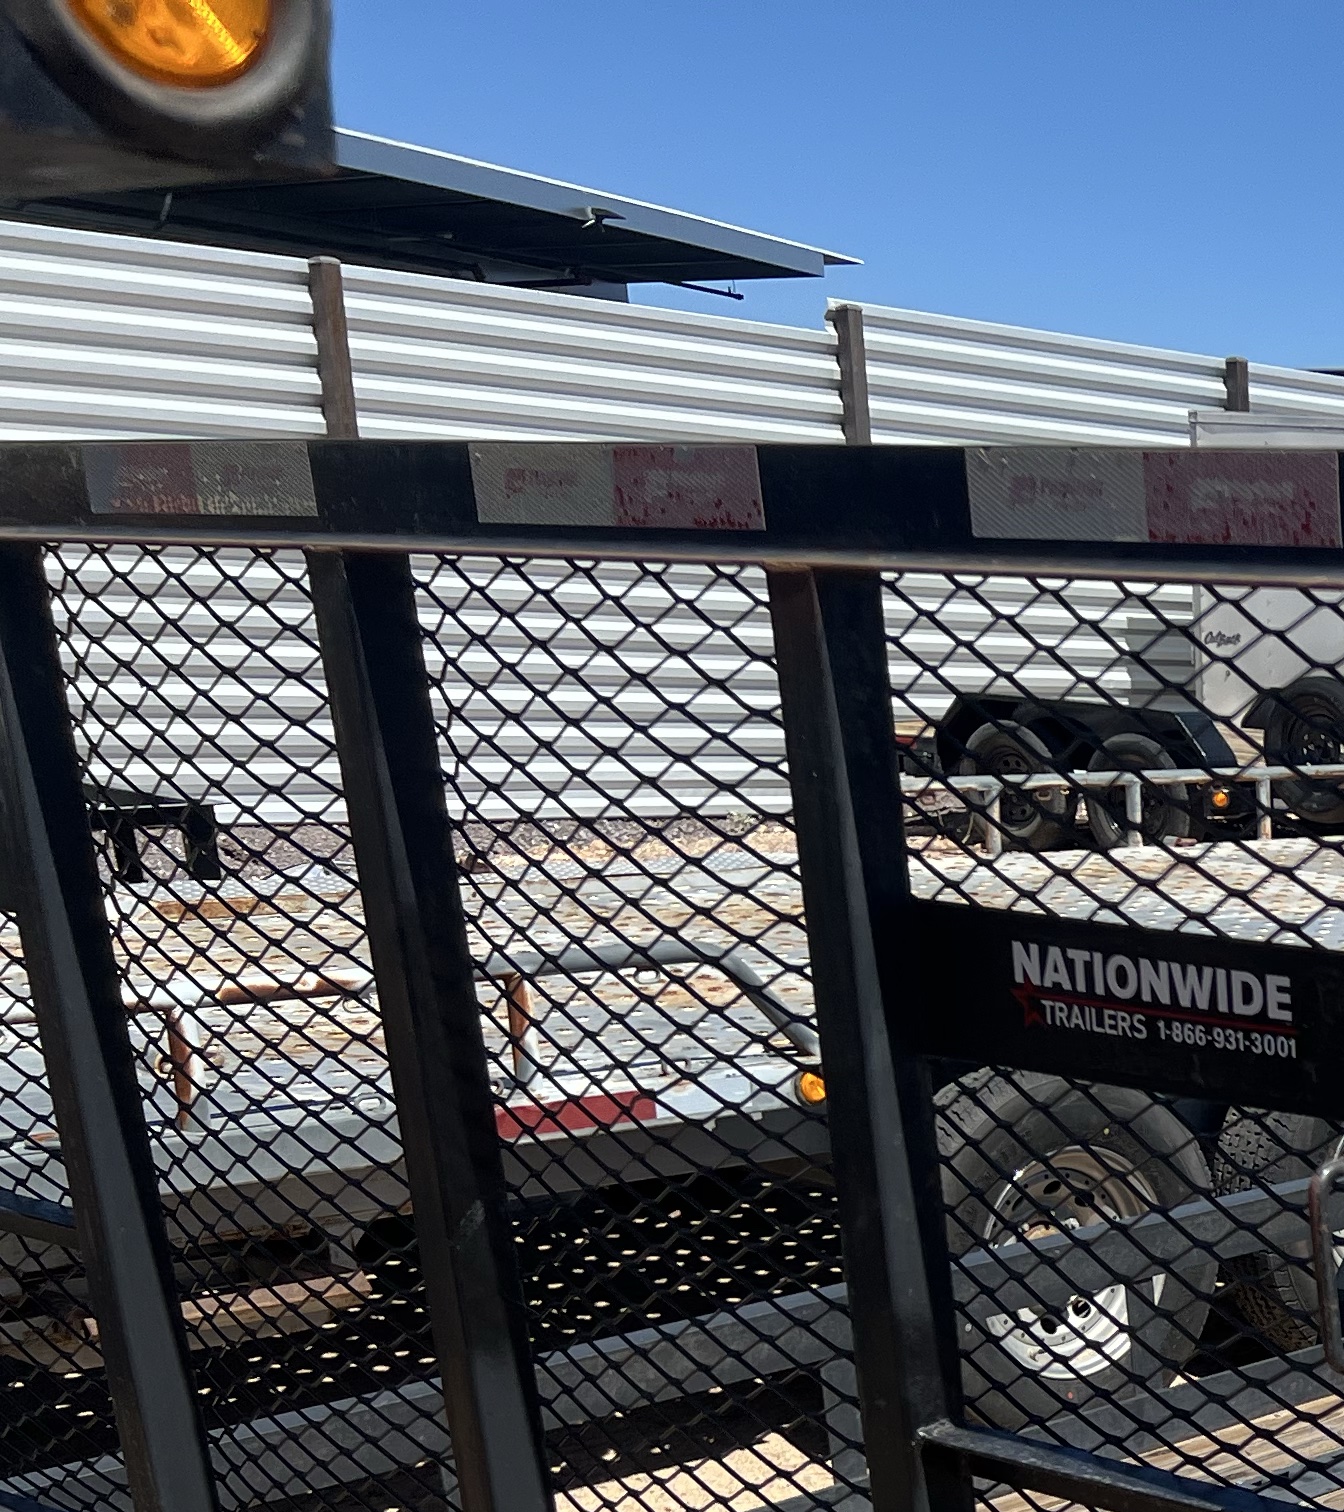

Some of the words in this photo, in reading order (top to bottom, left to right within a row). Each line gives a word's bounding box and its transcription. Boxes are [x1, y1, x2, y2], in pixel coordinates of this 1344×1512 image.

[1011, 940, 1293, 1022] NATIONWIDE
[1040, 999, 1148, 1040] TRAILERS
[1156, 1019, 1297, 1059] 1-866-931-3001
